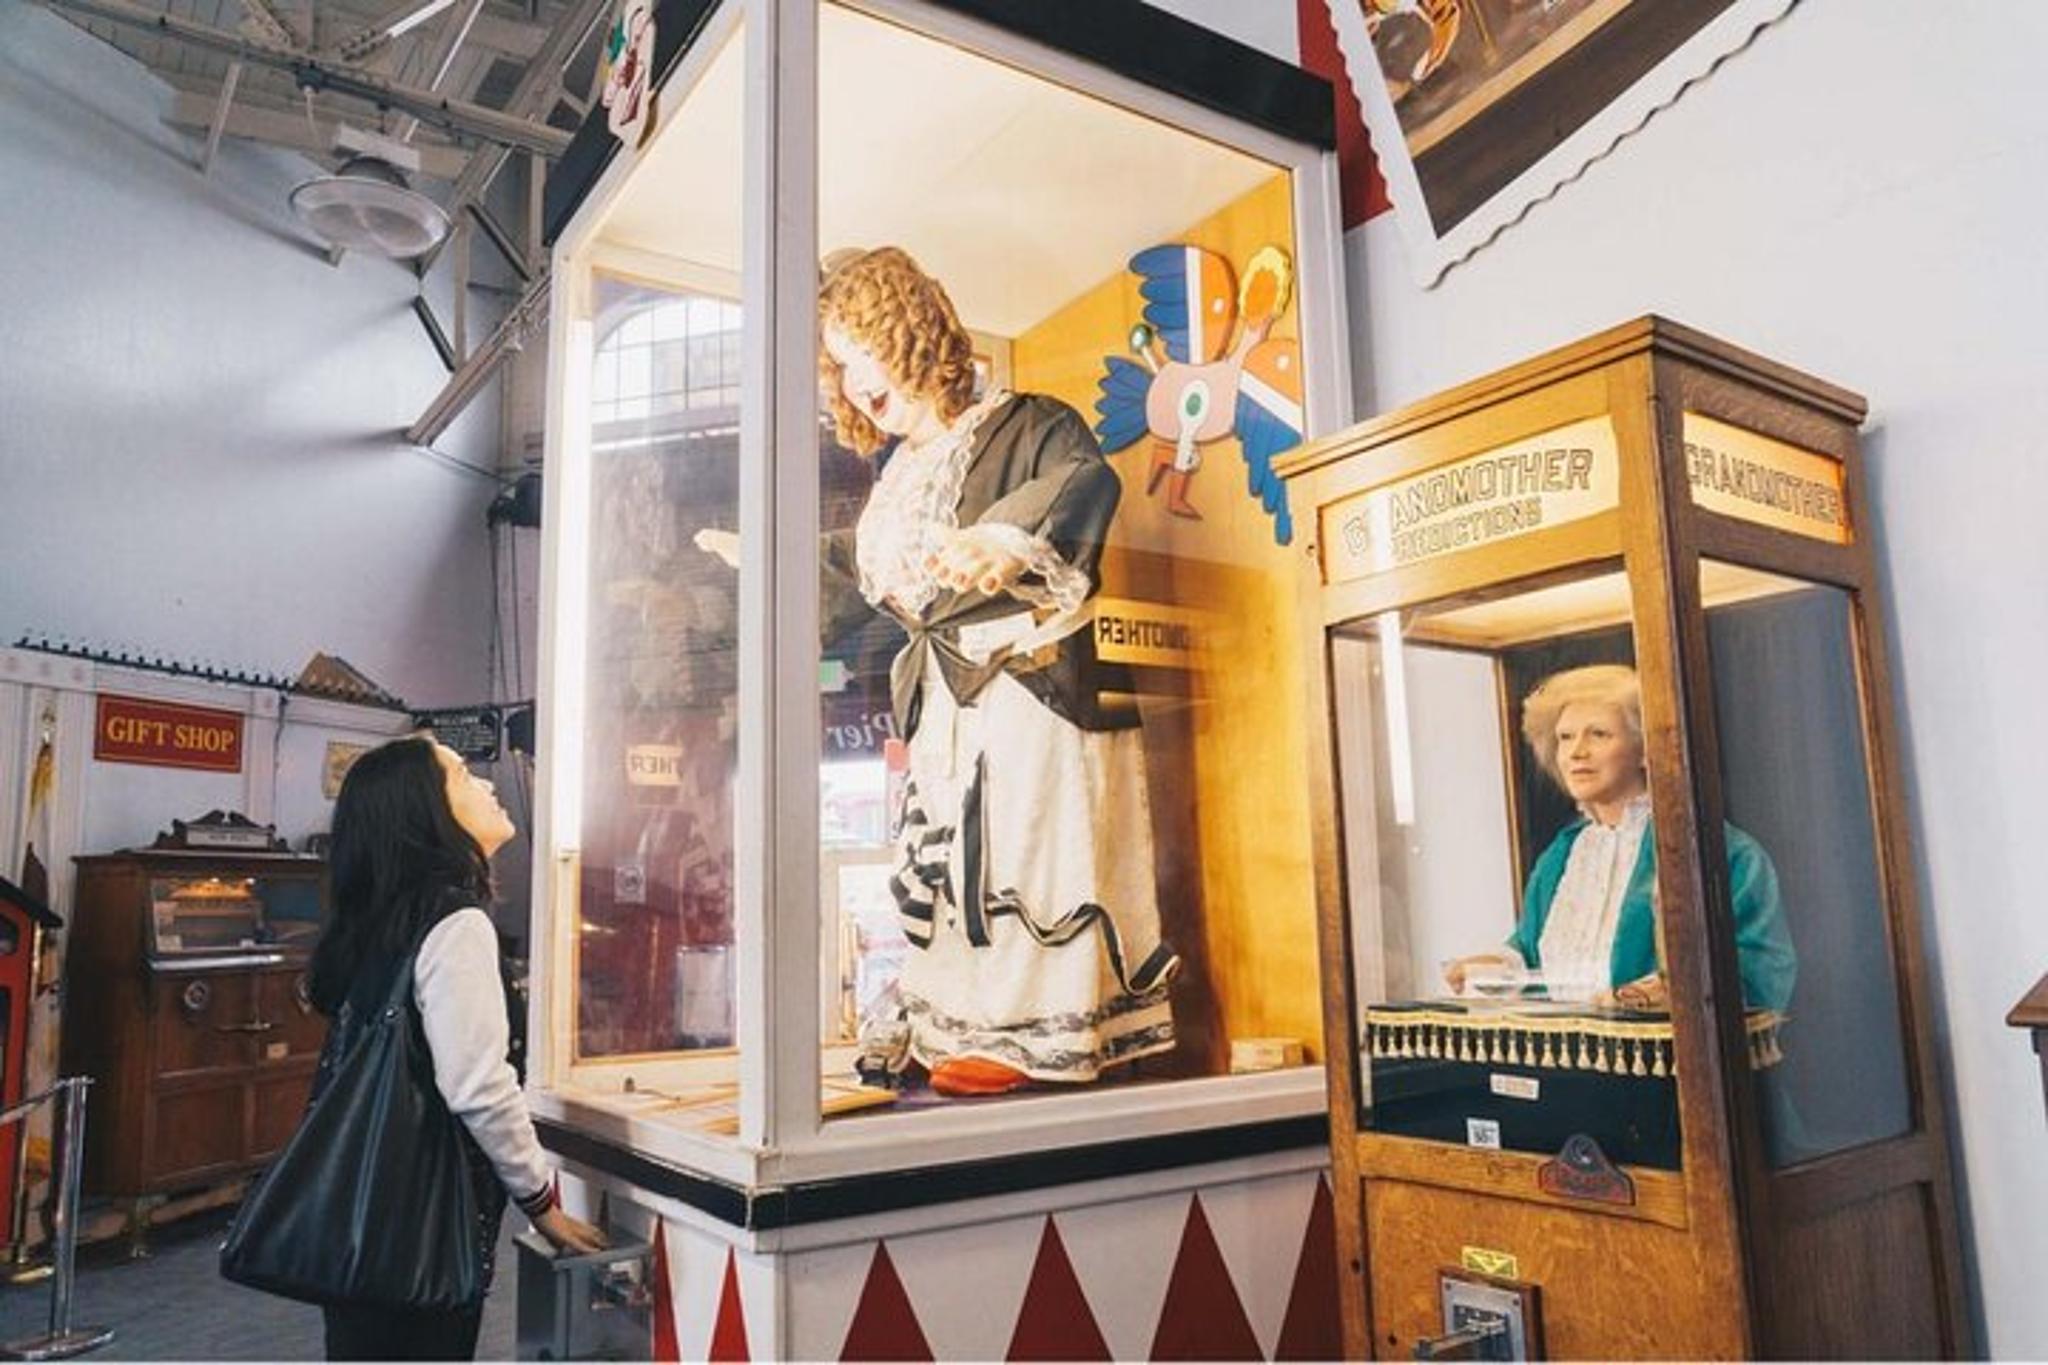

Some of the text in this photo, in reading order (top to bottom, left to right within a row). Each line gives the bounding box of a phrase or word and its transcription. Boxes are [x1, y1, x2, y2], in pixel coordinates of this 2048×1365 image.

[1343, 448, 1594, 557] GANDMOTHER
[107, 716, 234, 752] GIFT SHOP
